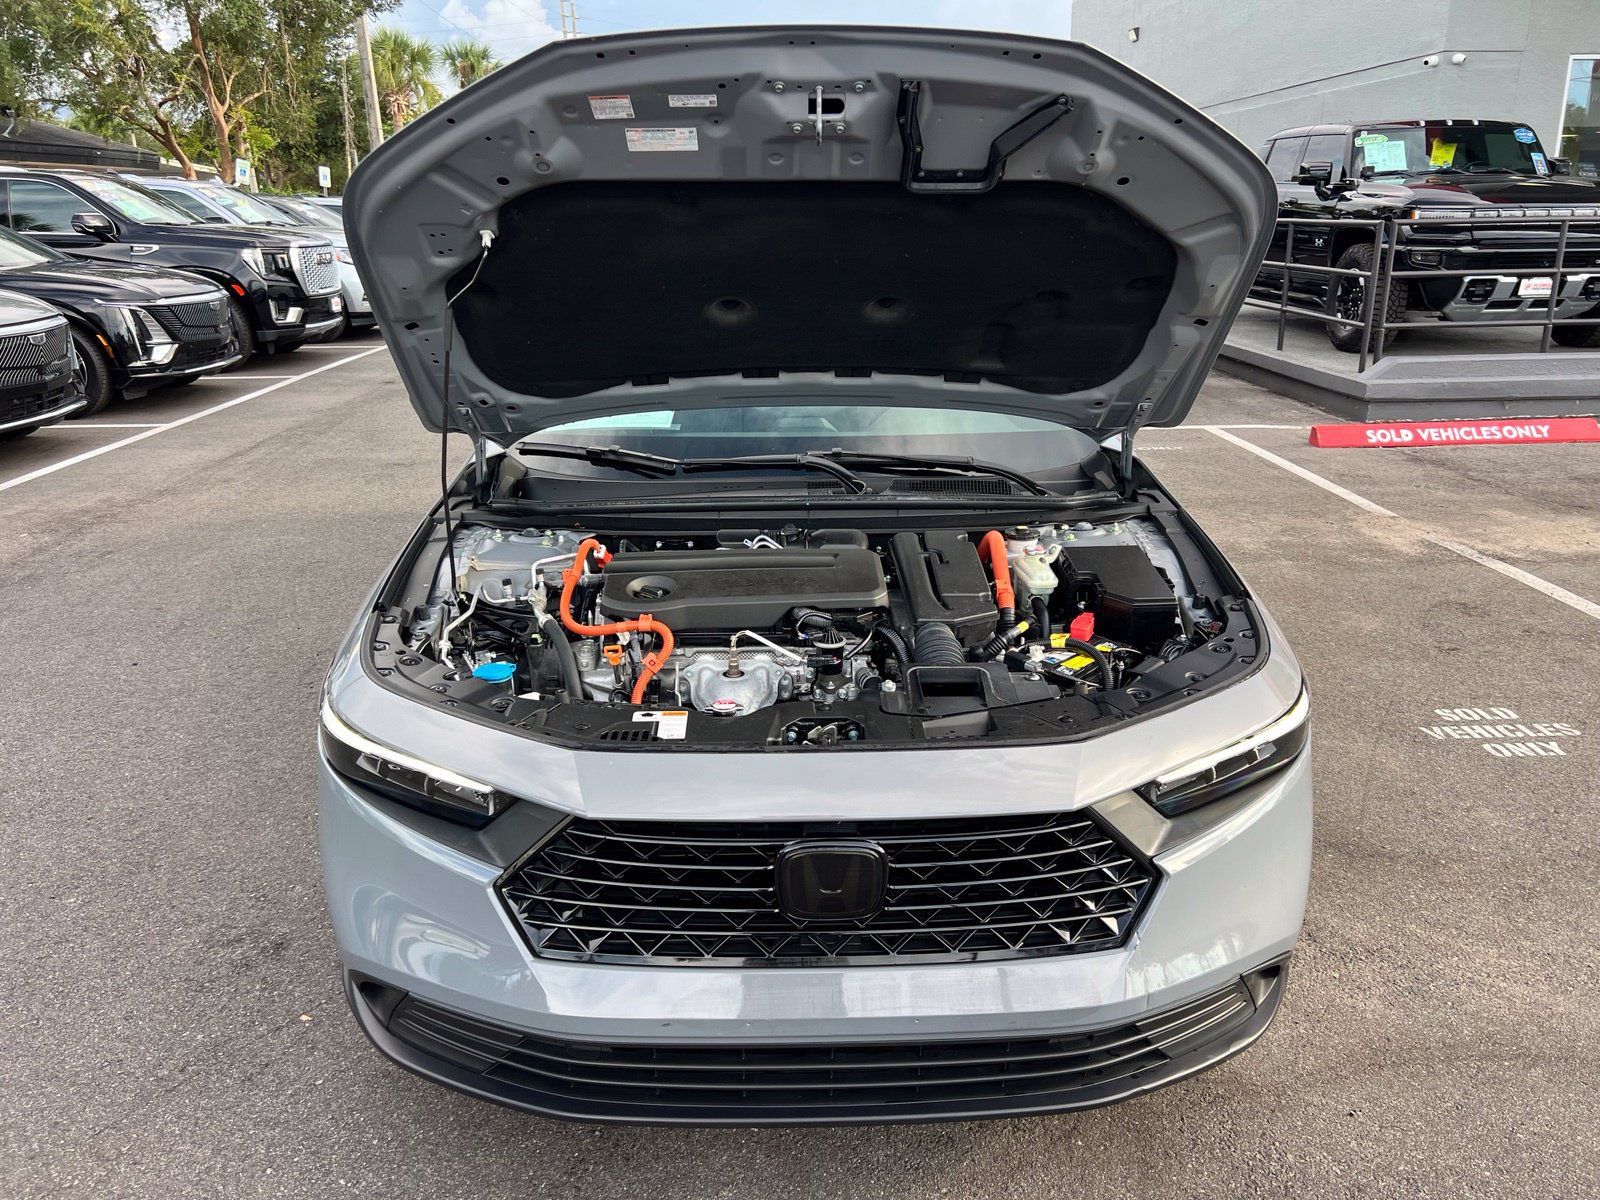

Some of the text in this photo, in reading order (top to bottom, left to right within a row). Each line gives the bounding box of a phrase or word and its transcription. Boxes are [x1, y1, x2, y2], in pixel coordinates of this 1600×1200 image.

[1366, 424, 1550, 443] SOLD VEHICLES ONLY
[1434, 707, 1519, 721] SOLD
[1418, 722, 1582, 740] VEHICLES
[1482, 741, 1567, 757] ONLY
